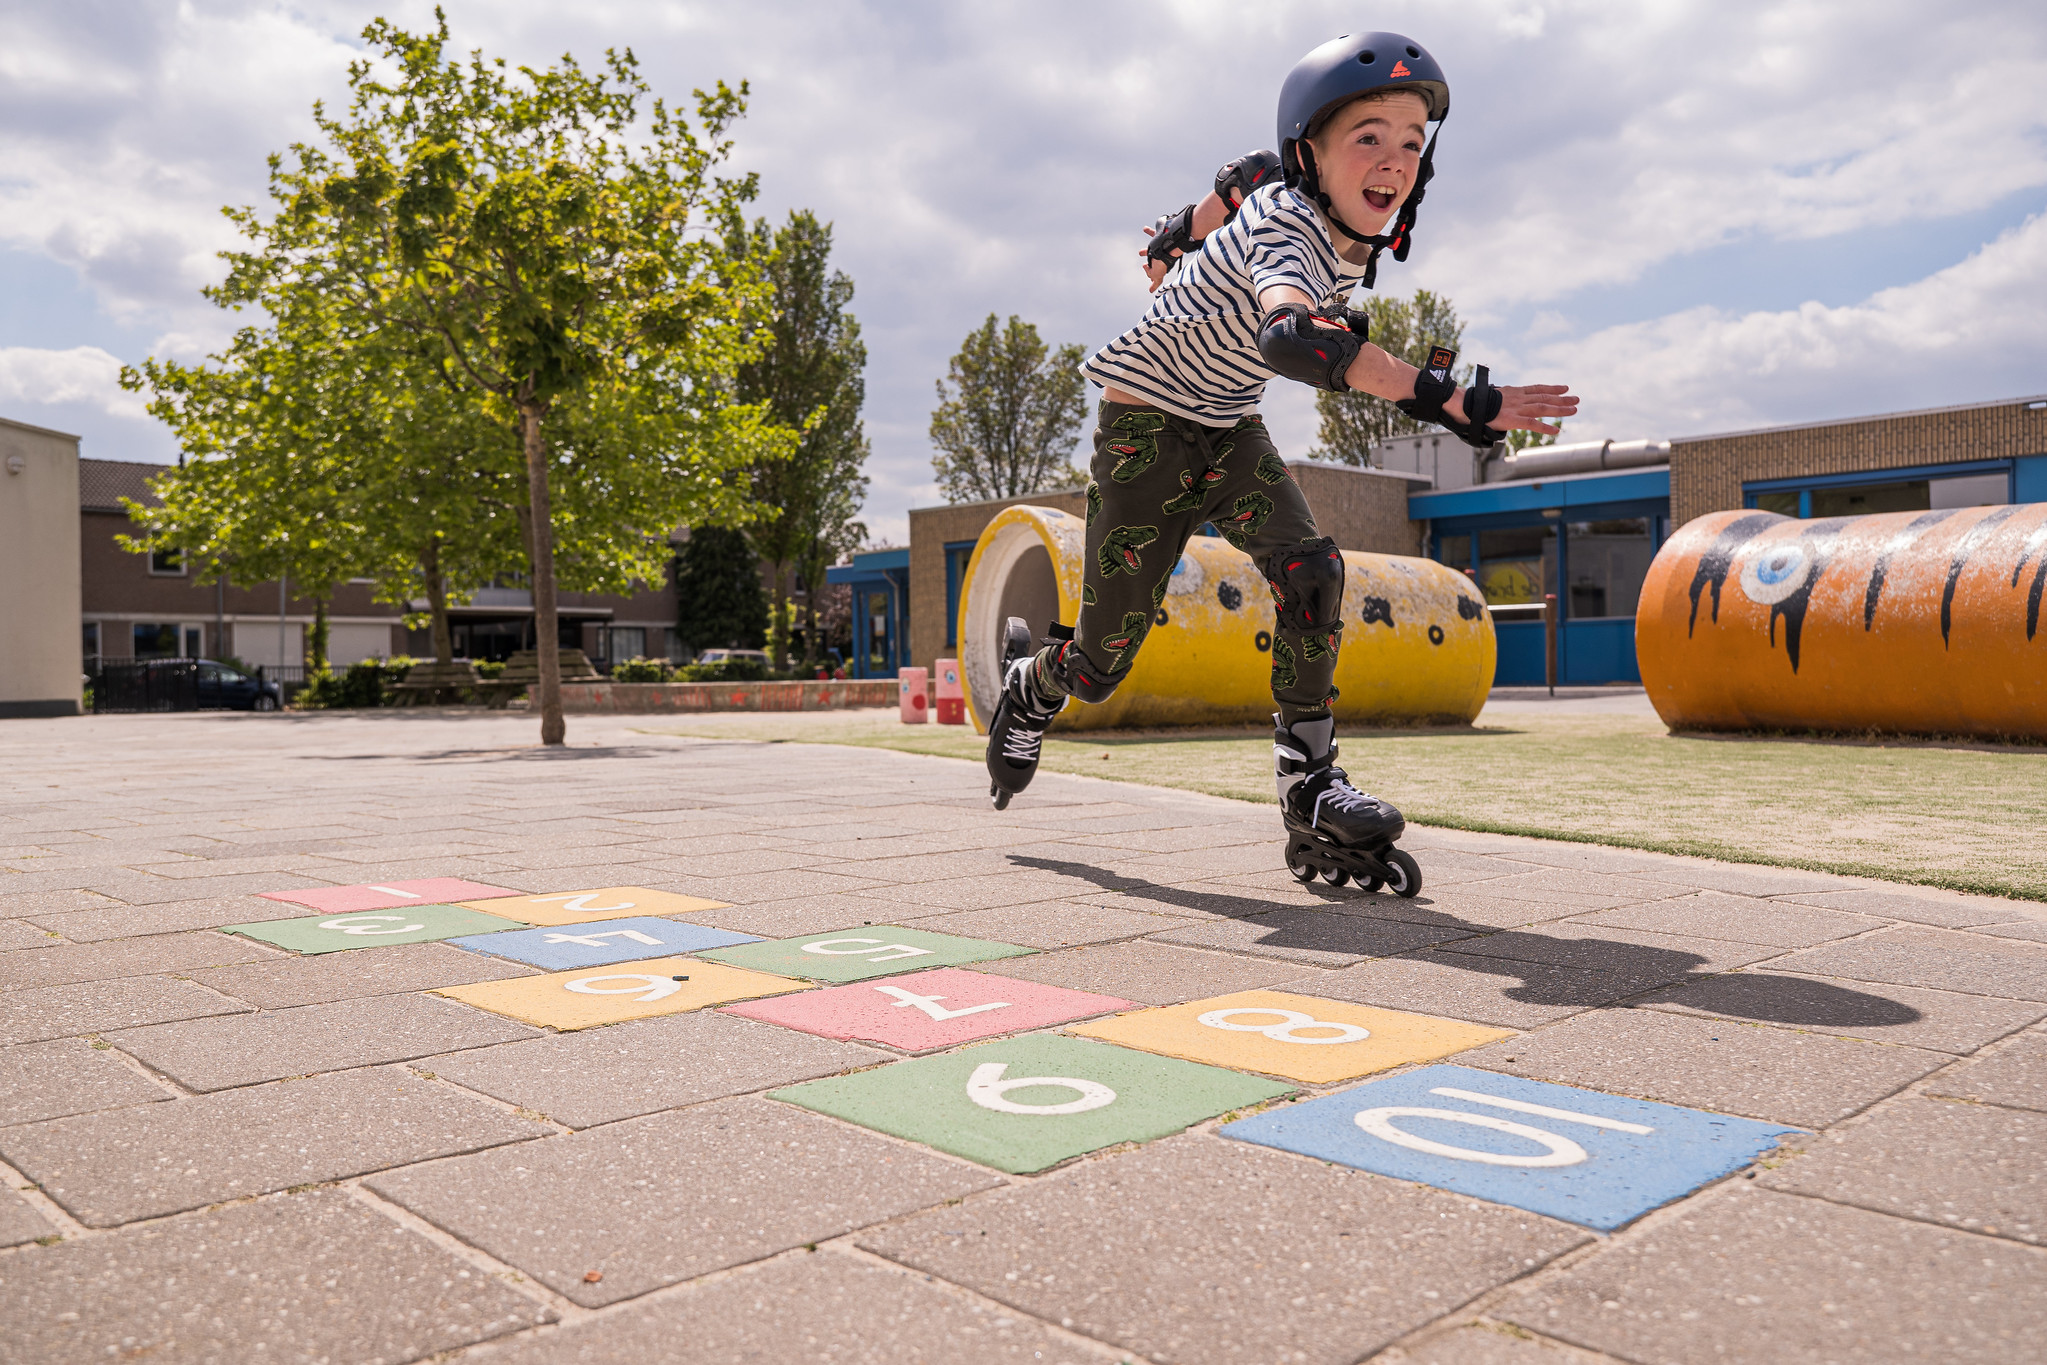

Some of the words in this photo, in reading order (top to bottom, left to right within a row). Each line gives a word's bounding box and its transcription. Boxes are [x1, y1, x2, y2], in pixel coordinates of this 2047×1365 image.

[368, 886, 421, 899] 1
[531, 893, 636, 911] 2
[318, 915, 425, 935] 3
[542, 929, 665, 946] 4
[800, 938, 936, 962] 5
[563, 974, 682, 1001] 6
[874, 986, 1012, 1022] 7
[1196, 1007, 1371, 1044] 8
[966, 1062, 1117, 1116] 9
[1353, 1086, 1655, 1168] 10
